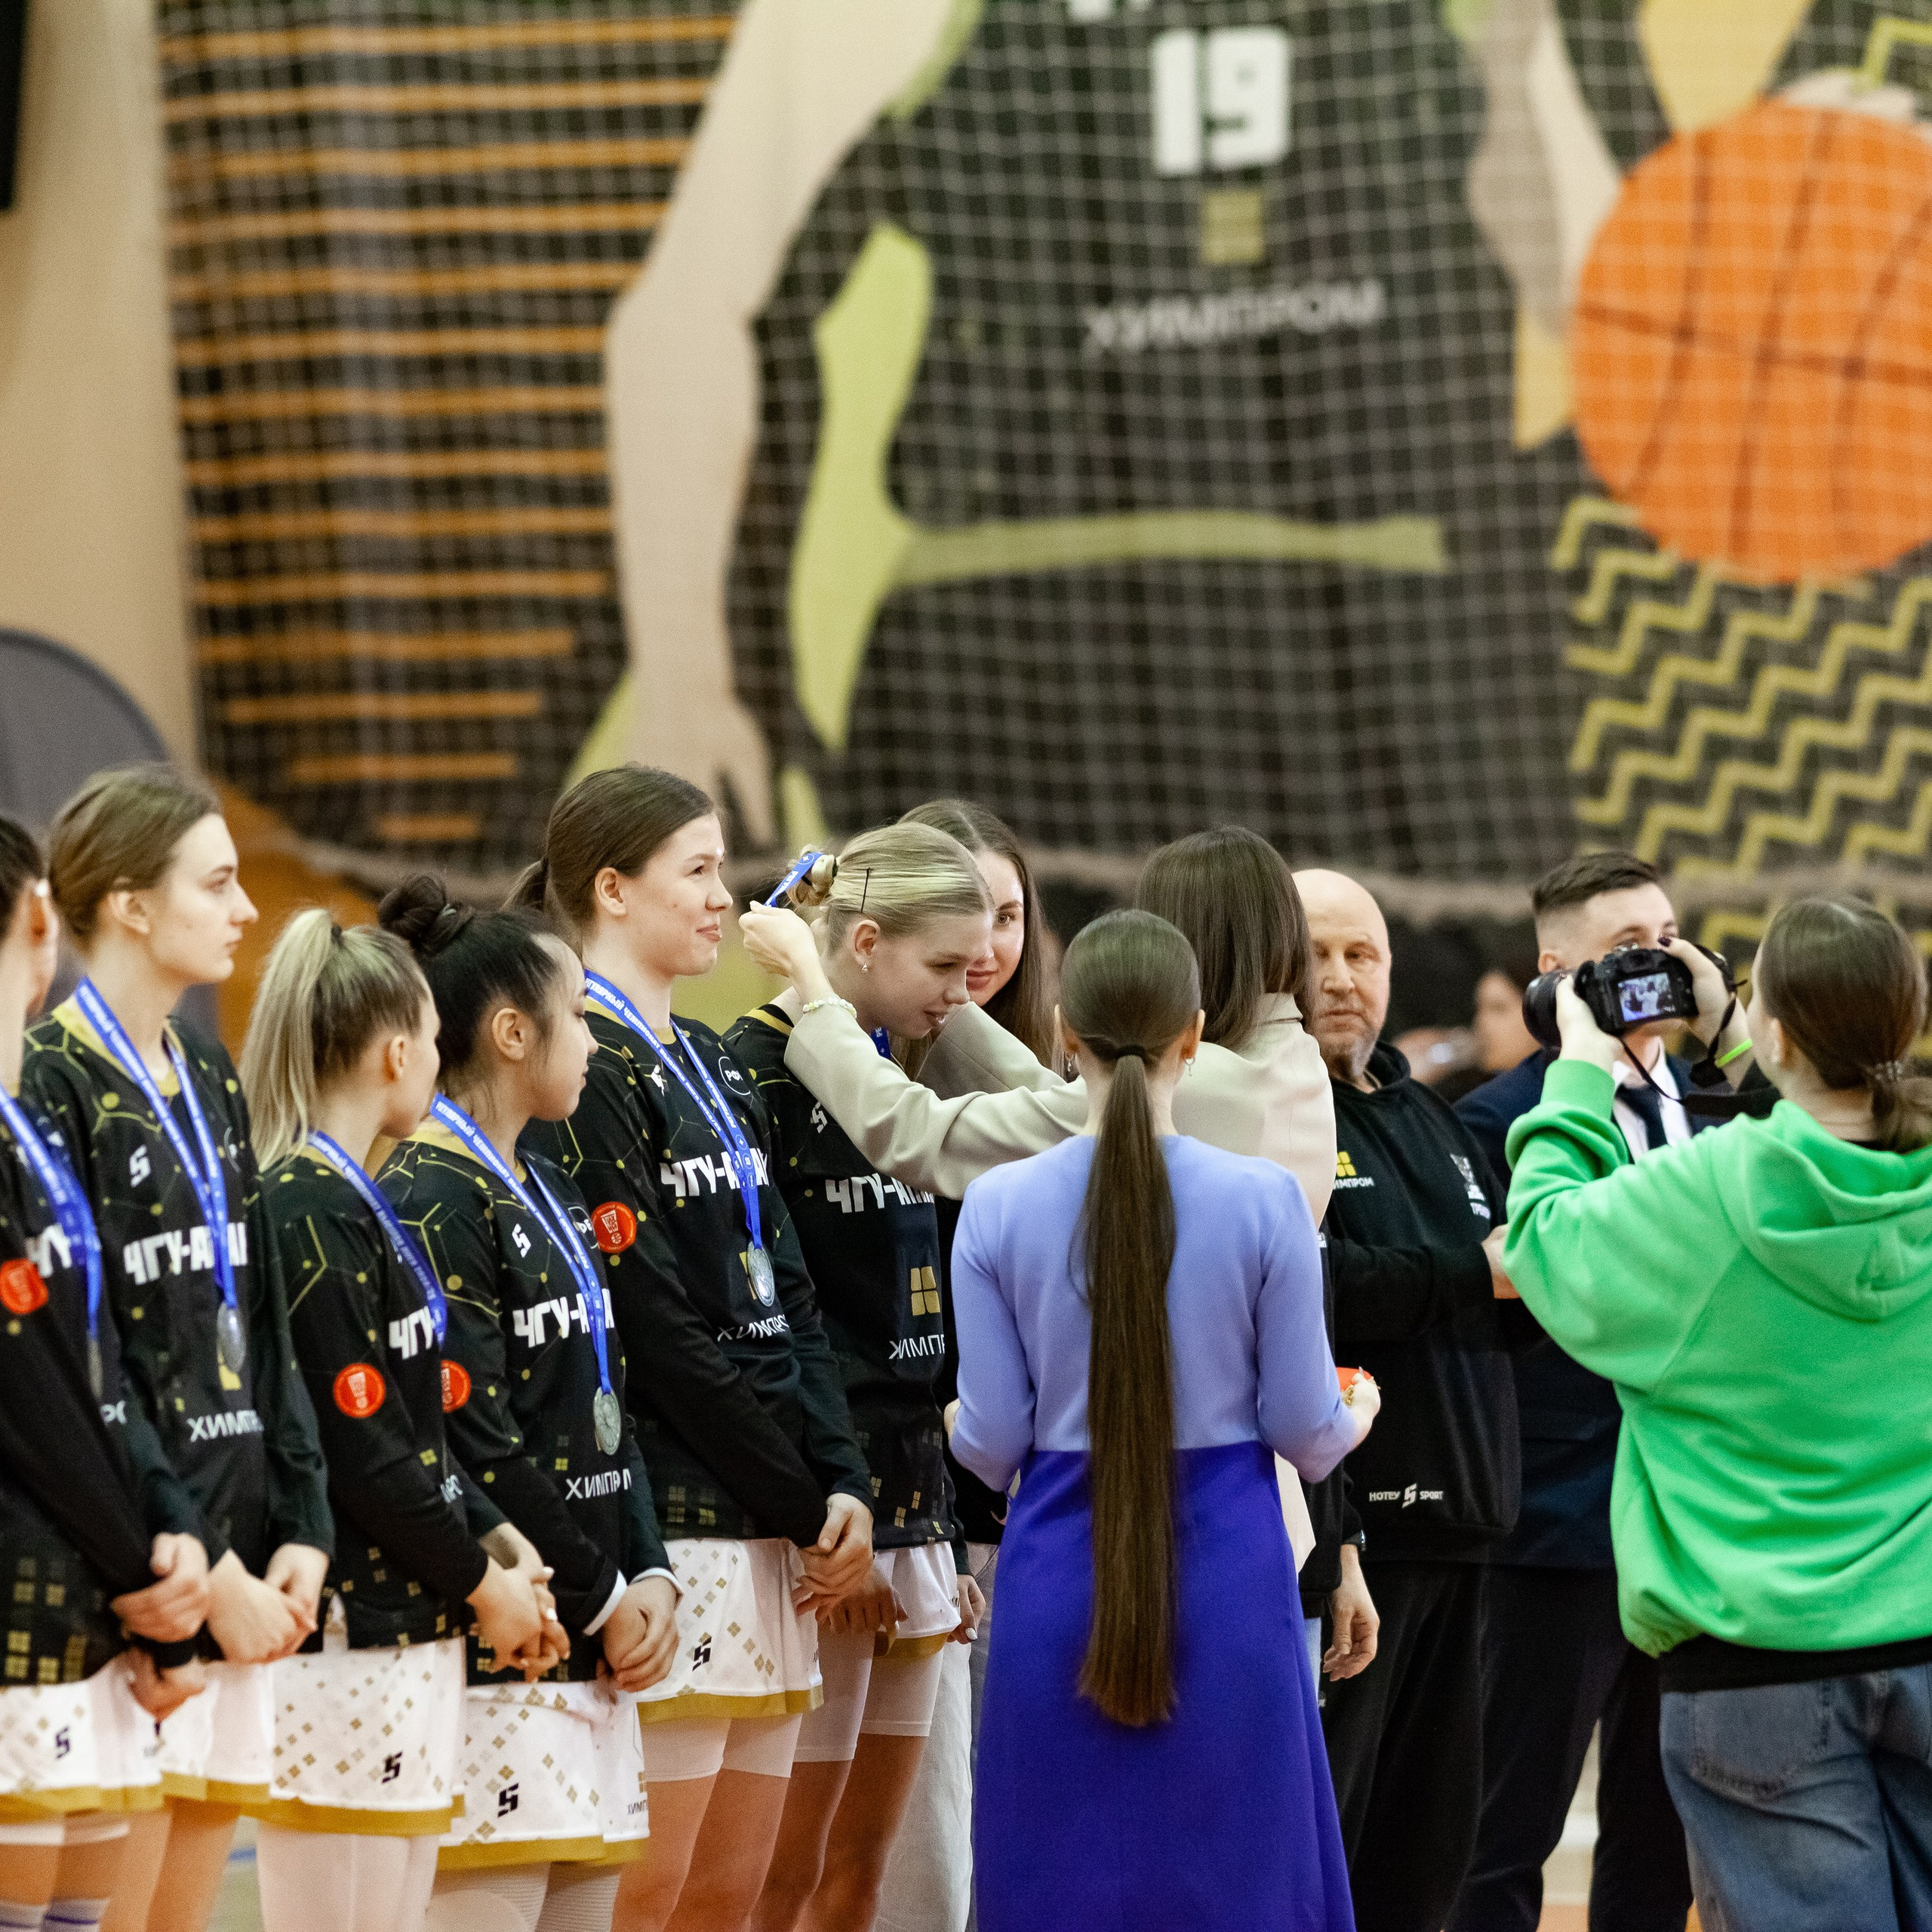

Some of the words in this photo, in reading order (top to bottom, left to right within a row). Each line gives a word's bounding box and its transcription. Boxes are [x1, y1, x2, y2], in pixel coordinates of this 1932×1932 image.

[1152, 26, 1289, 177] 19
[1369, 1491, 1401, 1502] HOTEY
[1420, 1491, 1443, 1500] SPORT
